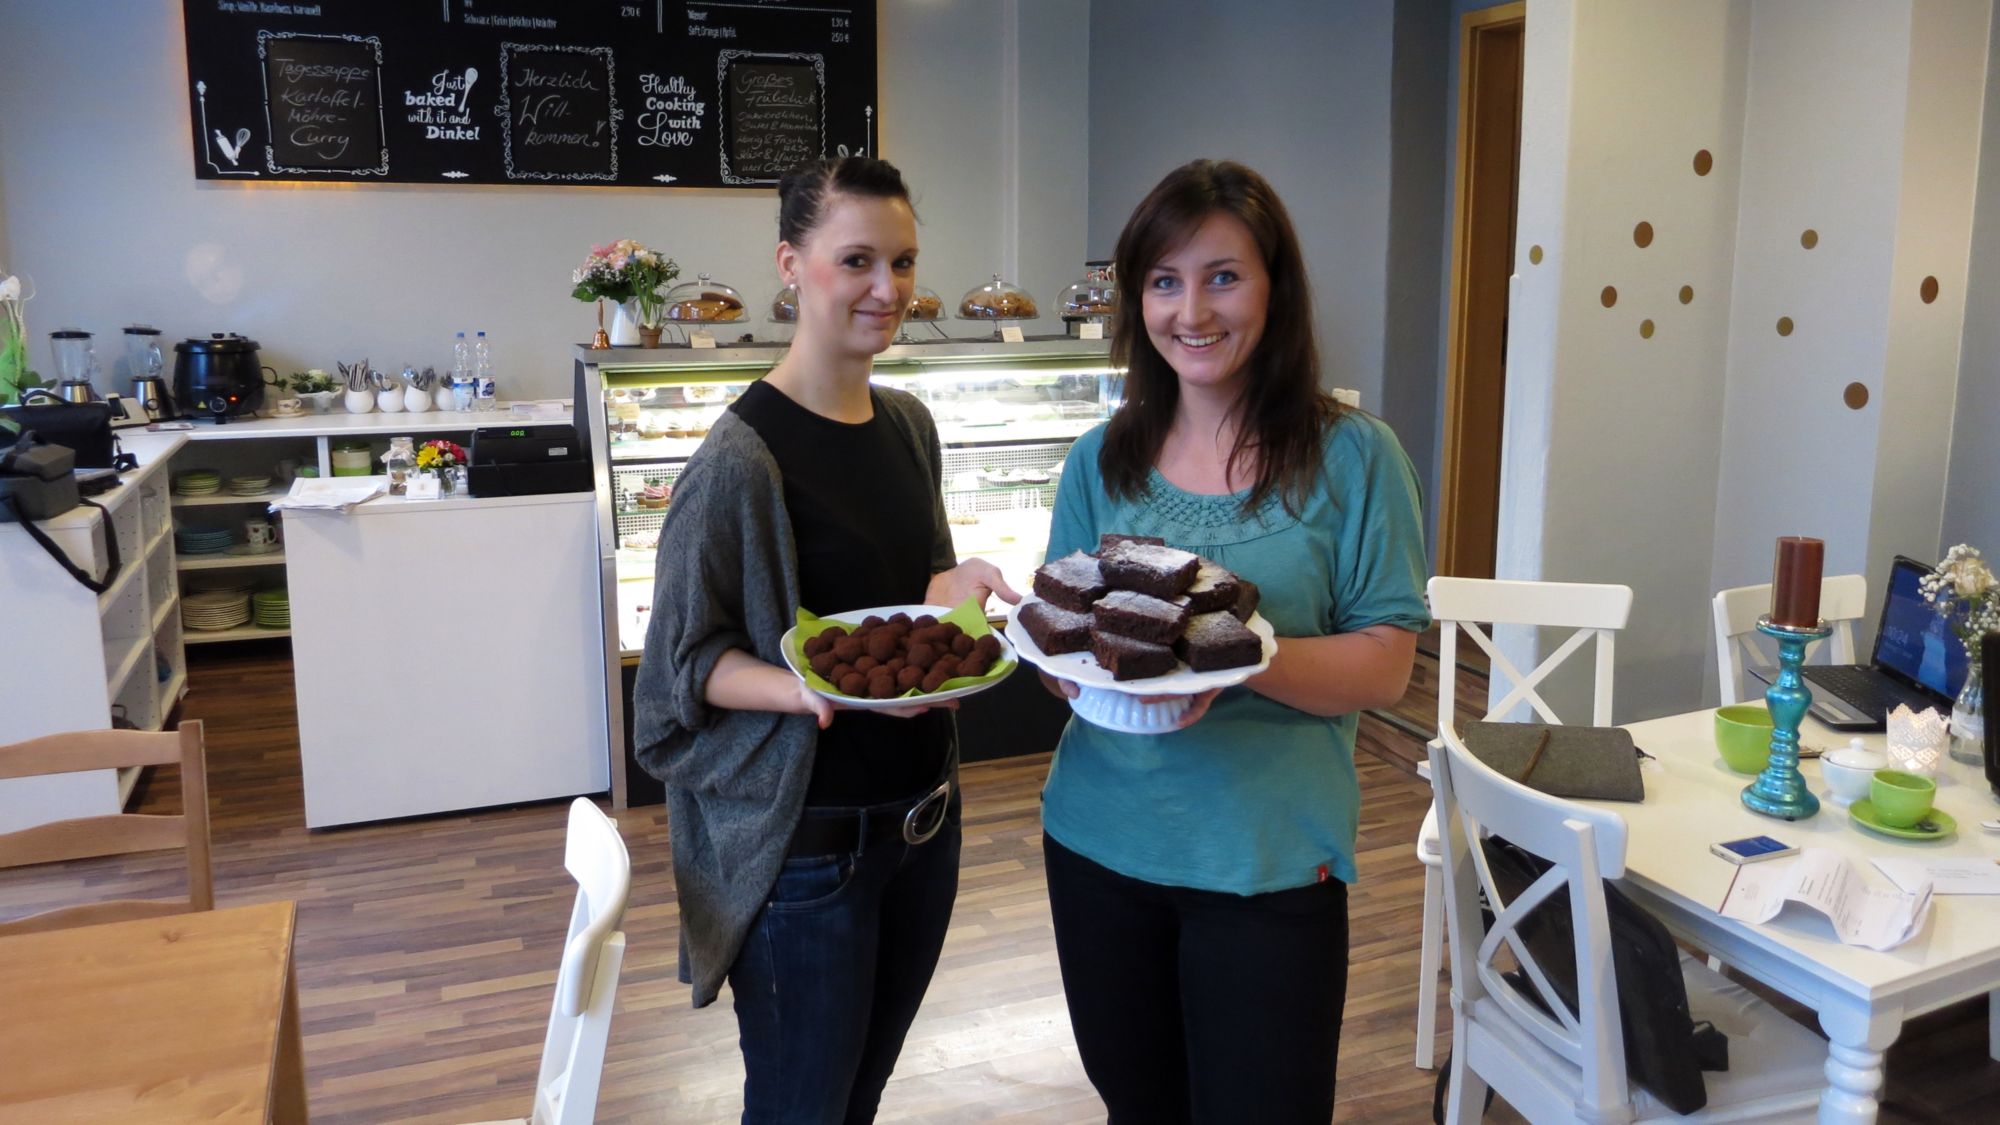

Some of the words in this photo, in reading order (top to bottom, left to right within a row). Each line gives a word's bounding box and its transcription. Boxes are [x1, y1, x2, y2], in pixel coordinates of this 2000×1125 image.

[275, 58, 370, 83] Tagessuppe
[515, 69, 600, 91] Herzlich
[432, 69, 466, 95] Just
[639, 73, 697, 101] Healthy
[404, 90, 456, 107] baked
[646, 96, 706, 116] Cooking
[408, 107, 434, 124] with
[436, 108, 447, 124] it
[448, 107, 471, 125] and
[668, 115, 702, 130] with
[425, 126, 480, 141] Dinkel
[637, 111, 694, 148] Love
[290, 124, 350, 160] Curry
